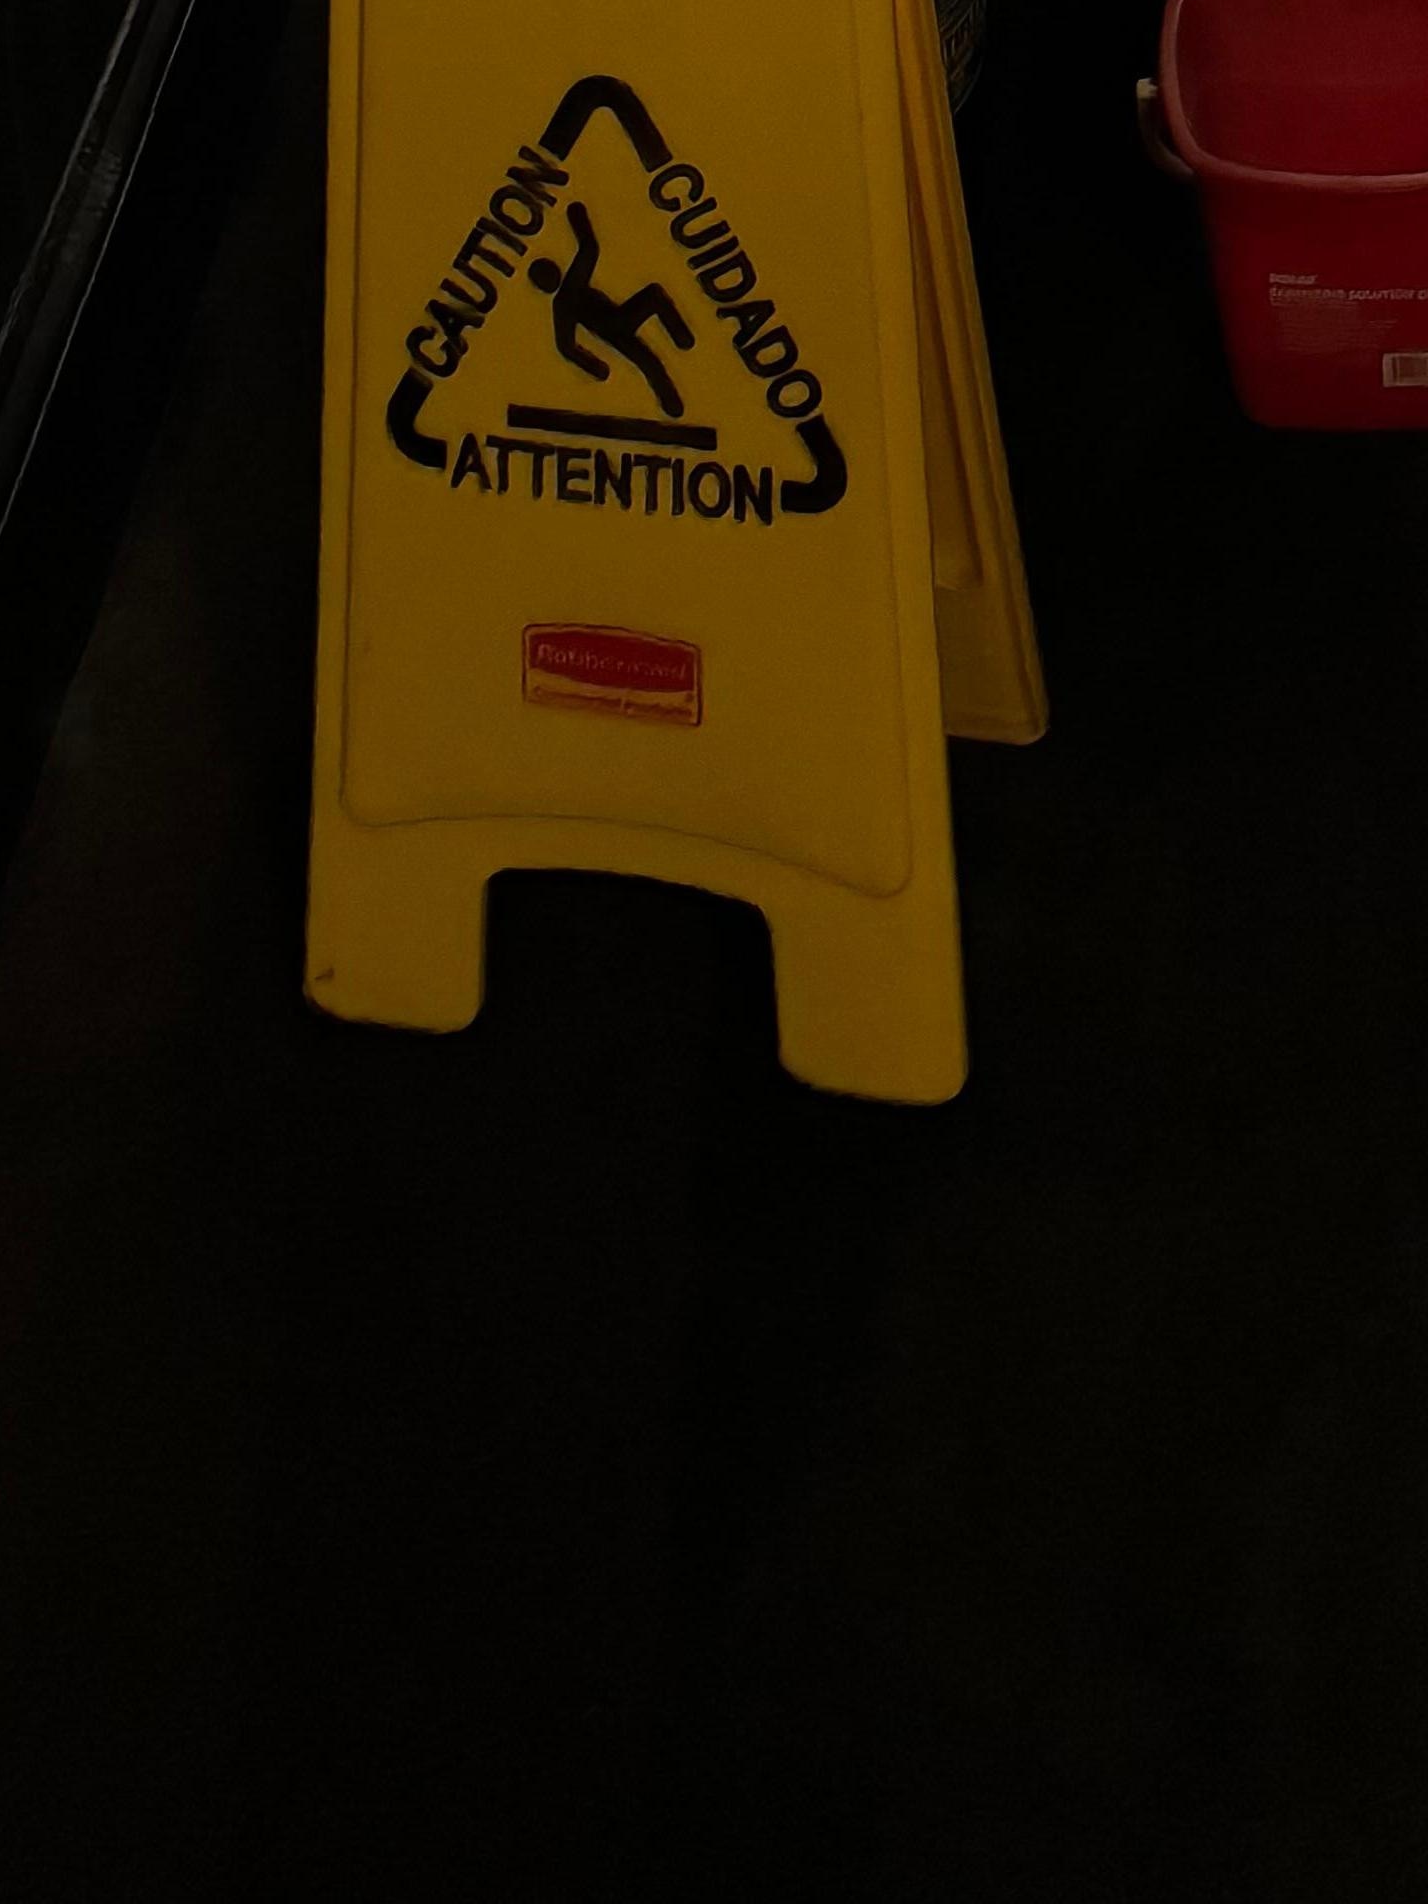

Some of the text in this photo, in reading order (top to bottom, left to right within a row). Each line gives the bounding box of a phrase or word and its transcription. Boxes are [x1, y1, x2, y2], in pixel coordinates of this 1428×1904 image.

[405, 145, 570, 379] CAUTION
[648, 162, 823, 419] CUIDADO
[451, 432, 773, 526] ATTENTION
